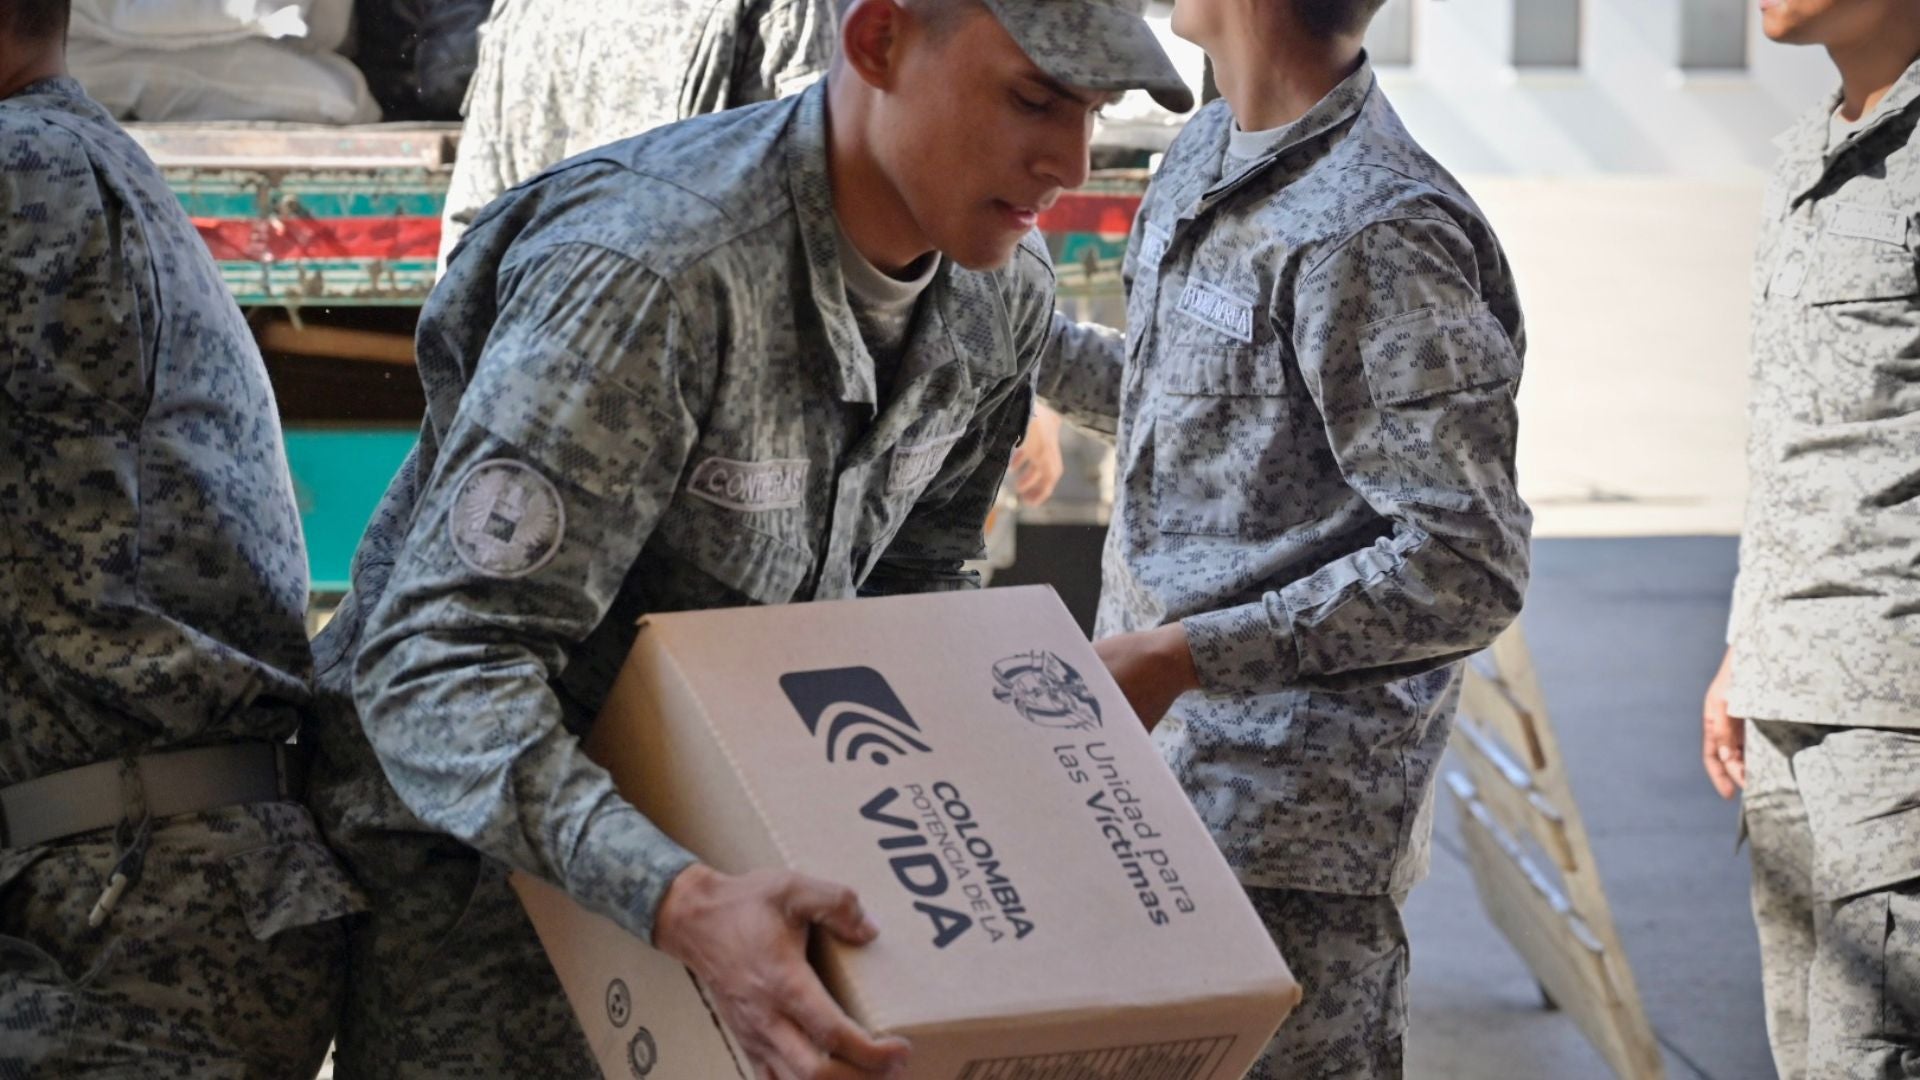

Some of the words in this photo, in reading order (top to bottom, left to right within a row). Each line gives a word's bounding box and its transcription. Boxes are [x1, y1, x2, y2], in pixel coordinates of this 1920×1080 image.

[859, 786, 973, 949] VIDA
[904, 783, 971, 881] POTENCIA
[962, 883, 993, 913] DE
[979, 914, 1006, 943] LA
[932, 781, 1035, 940] COLOMBIA
[1053, 744, 1090, 785] las
[1085, 790, 1170, 927] Víctimas
[1085, 741, 1161, 840] Unidad
[1142, 849, 1195, 914] para
